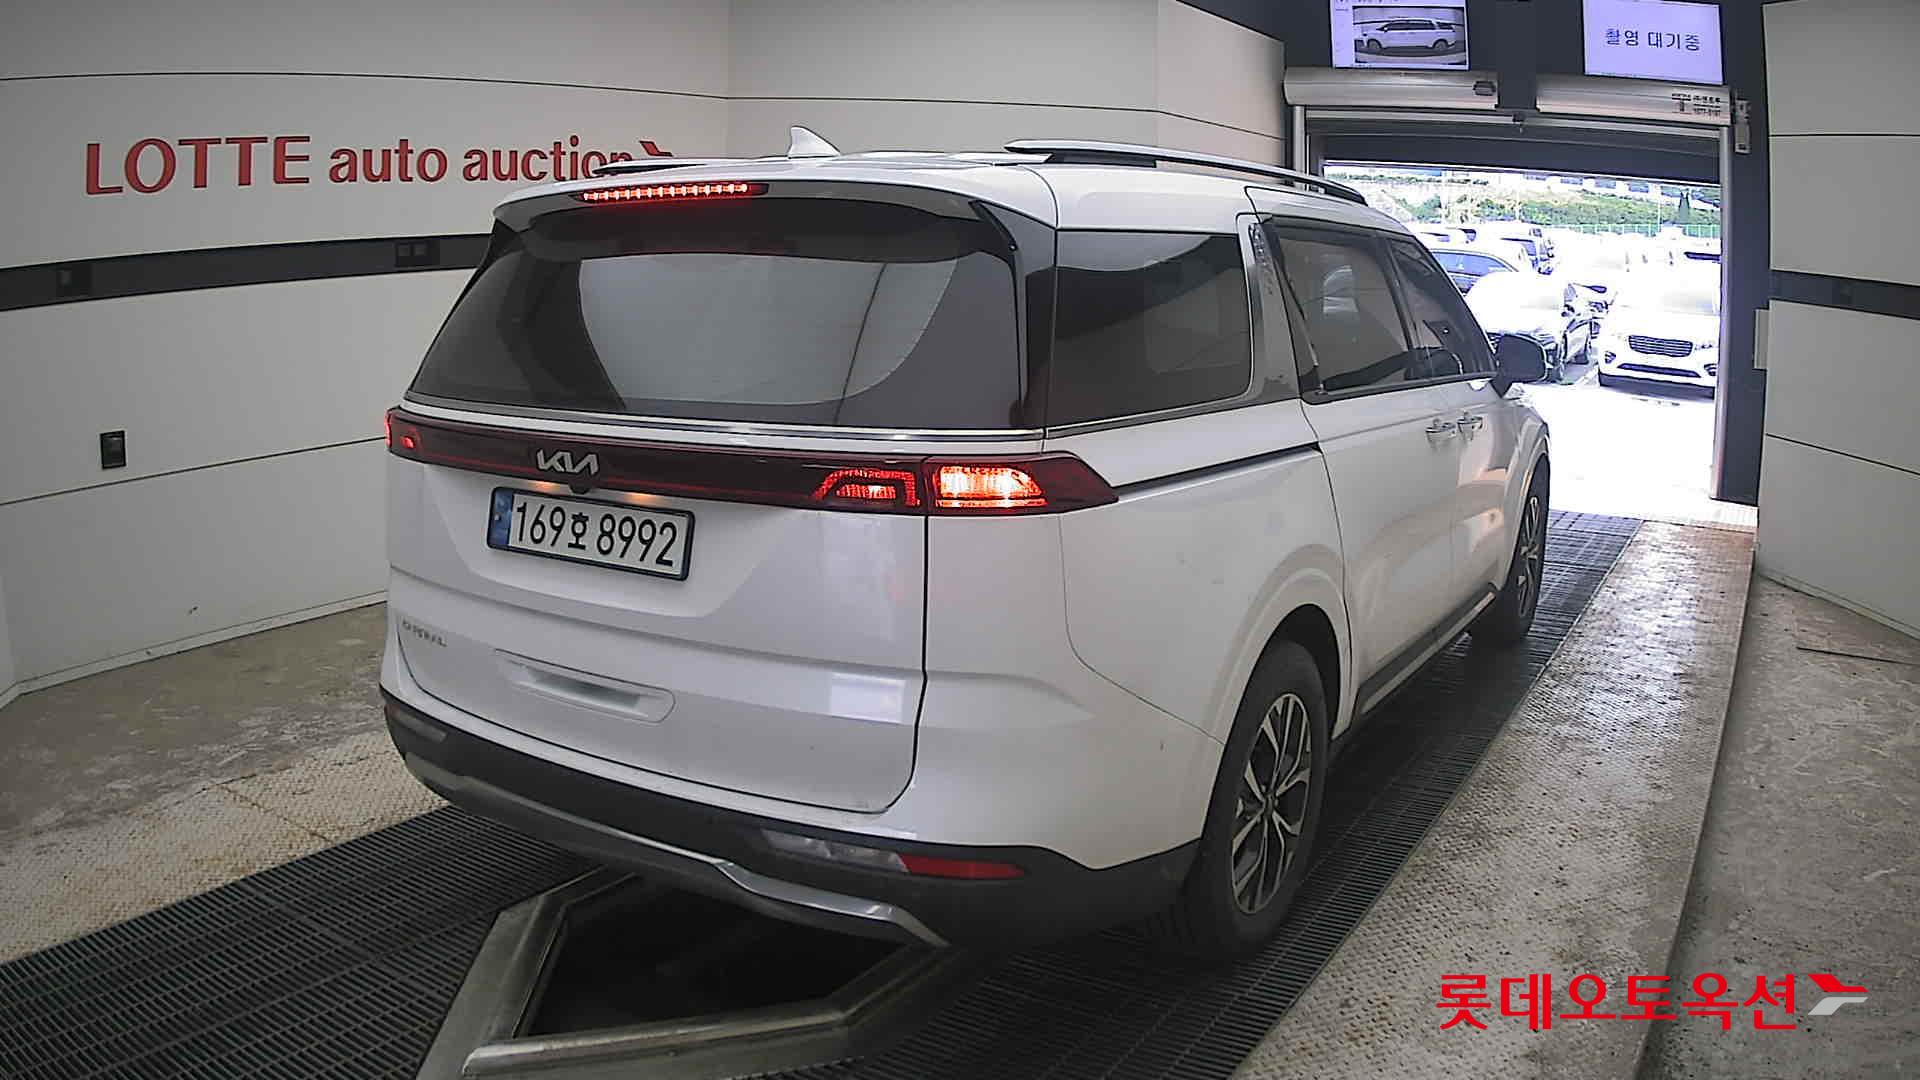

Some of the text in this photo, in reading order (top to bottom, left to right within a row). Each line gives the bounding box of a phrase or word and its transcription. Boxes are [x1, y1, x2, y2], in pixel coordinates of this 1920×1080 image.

[1647, 31, 1700, 51] 대기중
[85, 135, 311, 195] LOTTE
[328, 138, 448, 184] auto
[536, 449, 600, 476] KIA
[516, 501, 678, 567] 169호 8992
